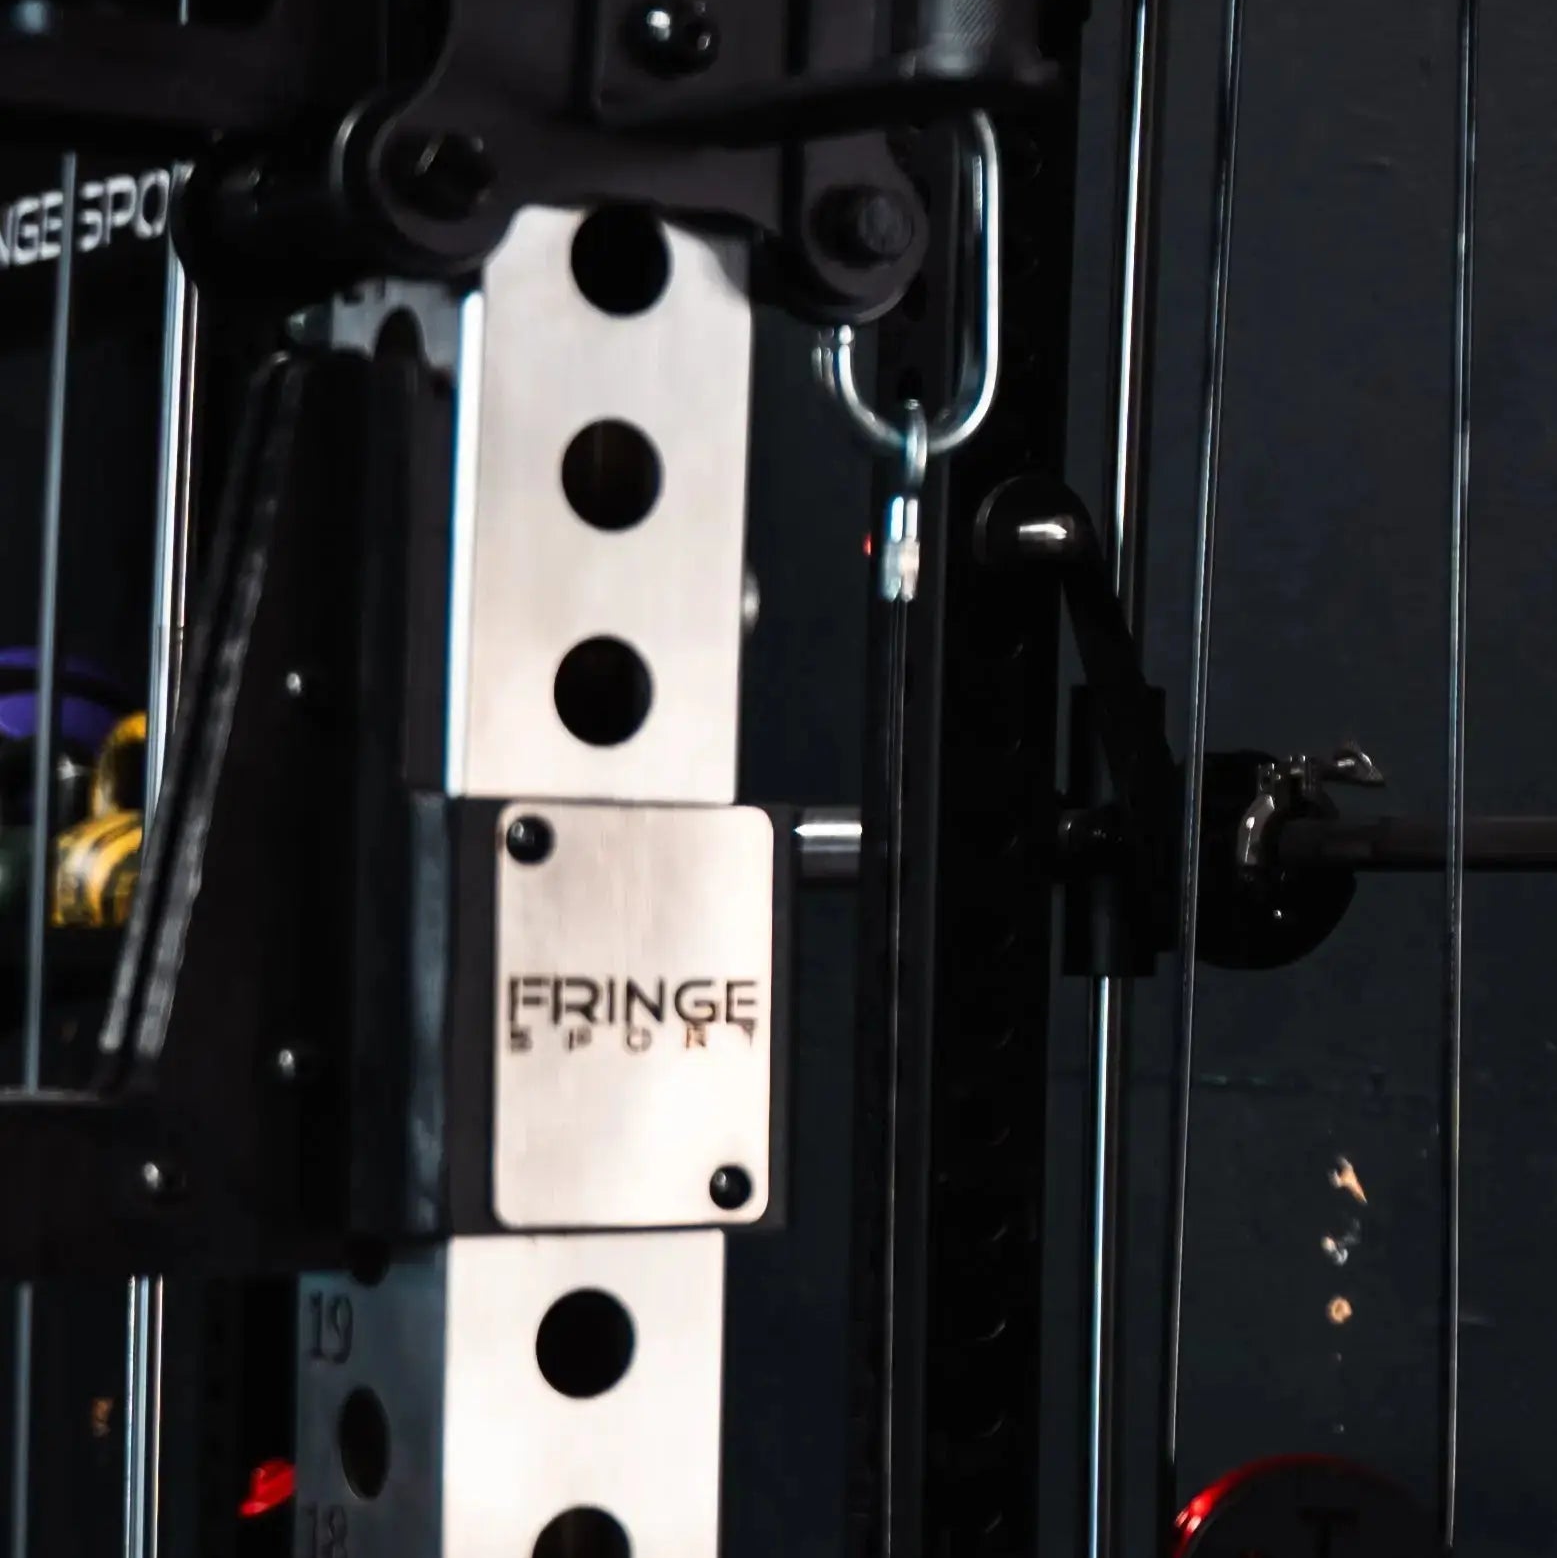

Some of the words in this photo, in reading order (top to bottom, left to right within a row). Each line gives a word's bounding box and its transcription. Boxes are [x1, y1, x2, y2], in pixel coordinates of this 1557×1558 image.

[77, 158, 196, 254] SPO
[508, 976, 757, 1025] FRINGE
[310, 1291, 353, 1365] 19
